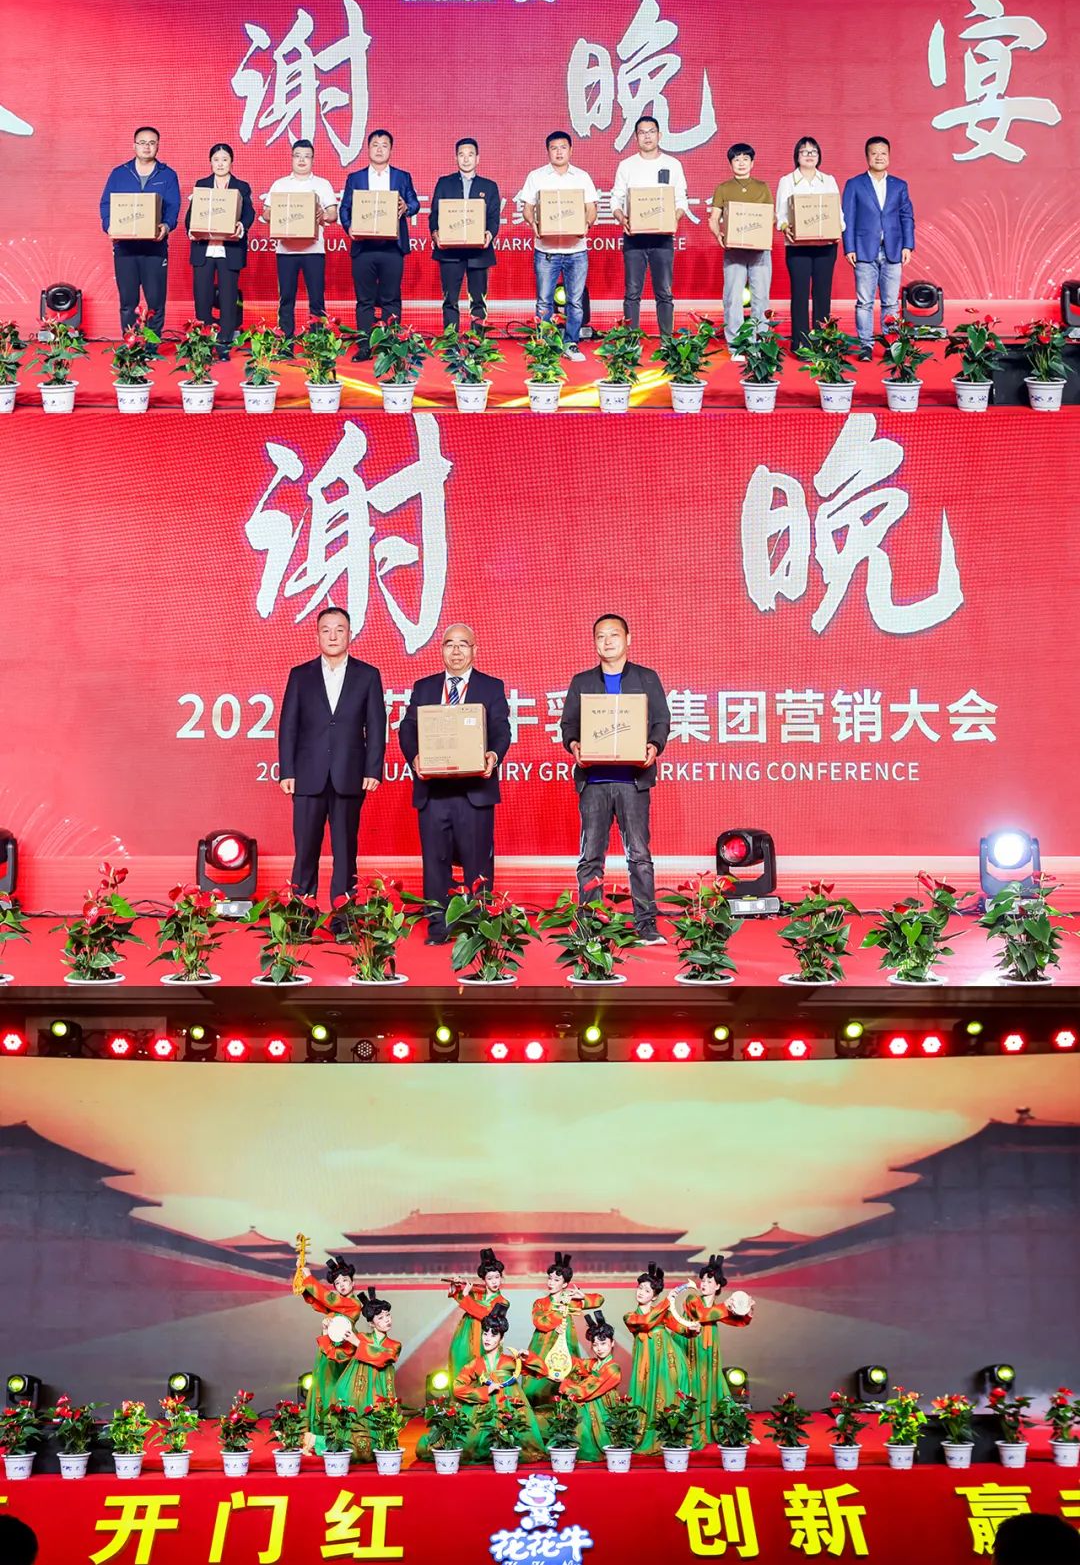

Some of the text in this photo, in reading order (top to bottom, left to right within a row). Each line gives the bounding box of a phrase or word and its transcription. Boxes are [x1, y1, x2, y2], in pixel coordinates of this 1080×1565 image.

[248, 238, 278, 251] 023
[667, 688, 998, 744] 集团营销大会
[655, 762, 760, 782] RKETING
[766, 762, 919, 782] CONFERENCE
[89, 1489, 404, 1565] 开门红
[675, 1482, 870, 1559] 创新
[489, 1524, 595, 1563] 花花牛
